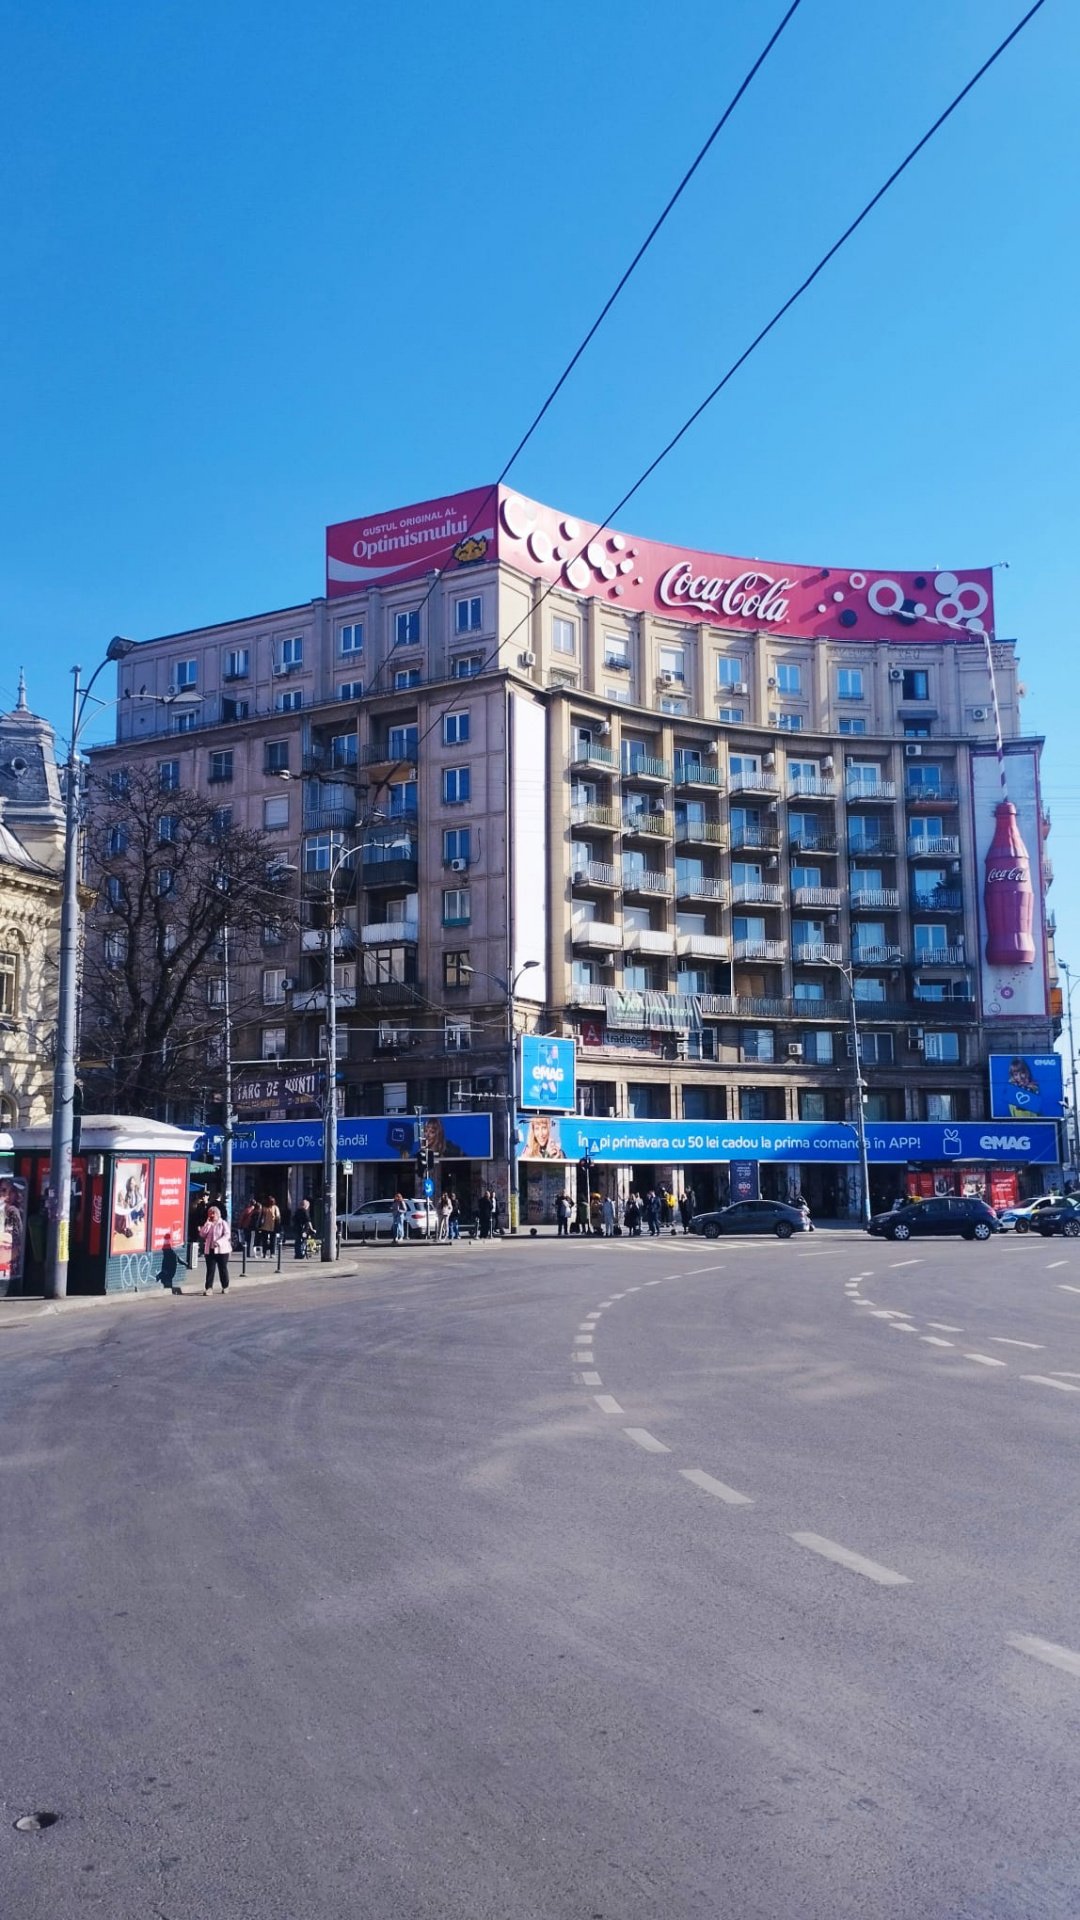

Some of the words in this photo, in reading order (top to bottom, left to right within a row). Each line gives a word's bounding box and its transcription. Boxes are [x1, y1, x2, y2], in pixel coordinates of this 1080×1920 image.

[363, 522, 398, 537] GUSTUL
[400, 512, 442, 528] ORIGINAL
[445, 507, 457, 516] AL
[353, 515, 468, 559] Optimismului
[660, 561, 799, 623] Coca-Cola
[266, 1081, 279, 1097] DE
[260, 1136, 280, 1149] rate
[282, 1138, 295, 1148] cu
[297, 1135, 316, 1148] 0%
[317, 1133, 368, 1148] dândă!
[577, 1130, 610, 1149] Înpi
[612, 1134, 669, 1150] primăvara
[672, 1139, 686, 1148] cu
[688, 1136, 703, 1148] 50
[706, 1135, 719, 1148] lei
[721, 1135, 758, 1148] cadou
[761, 1136, 771, 1148] la
[774, 1136, 810, 1151] prima
[873, 1136, 886, 1149] în
[889, 1137, 921, 1149] APP!
[980, 1135, 1031, 1150] eMAG
